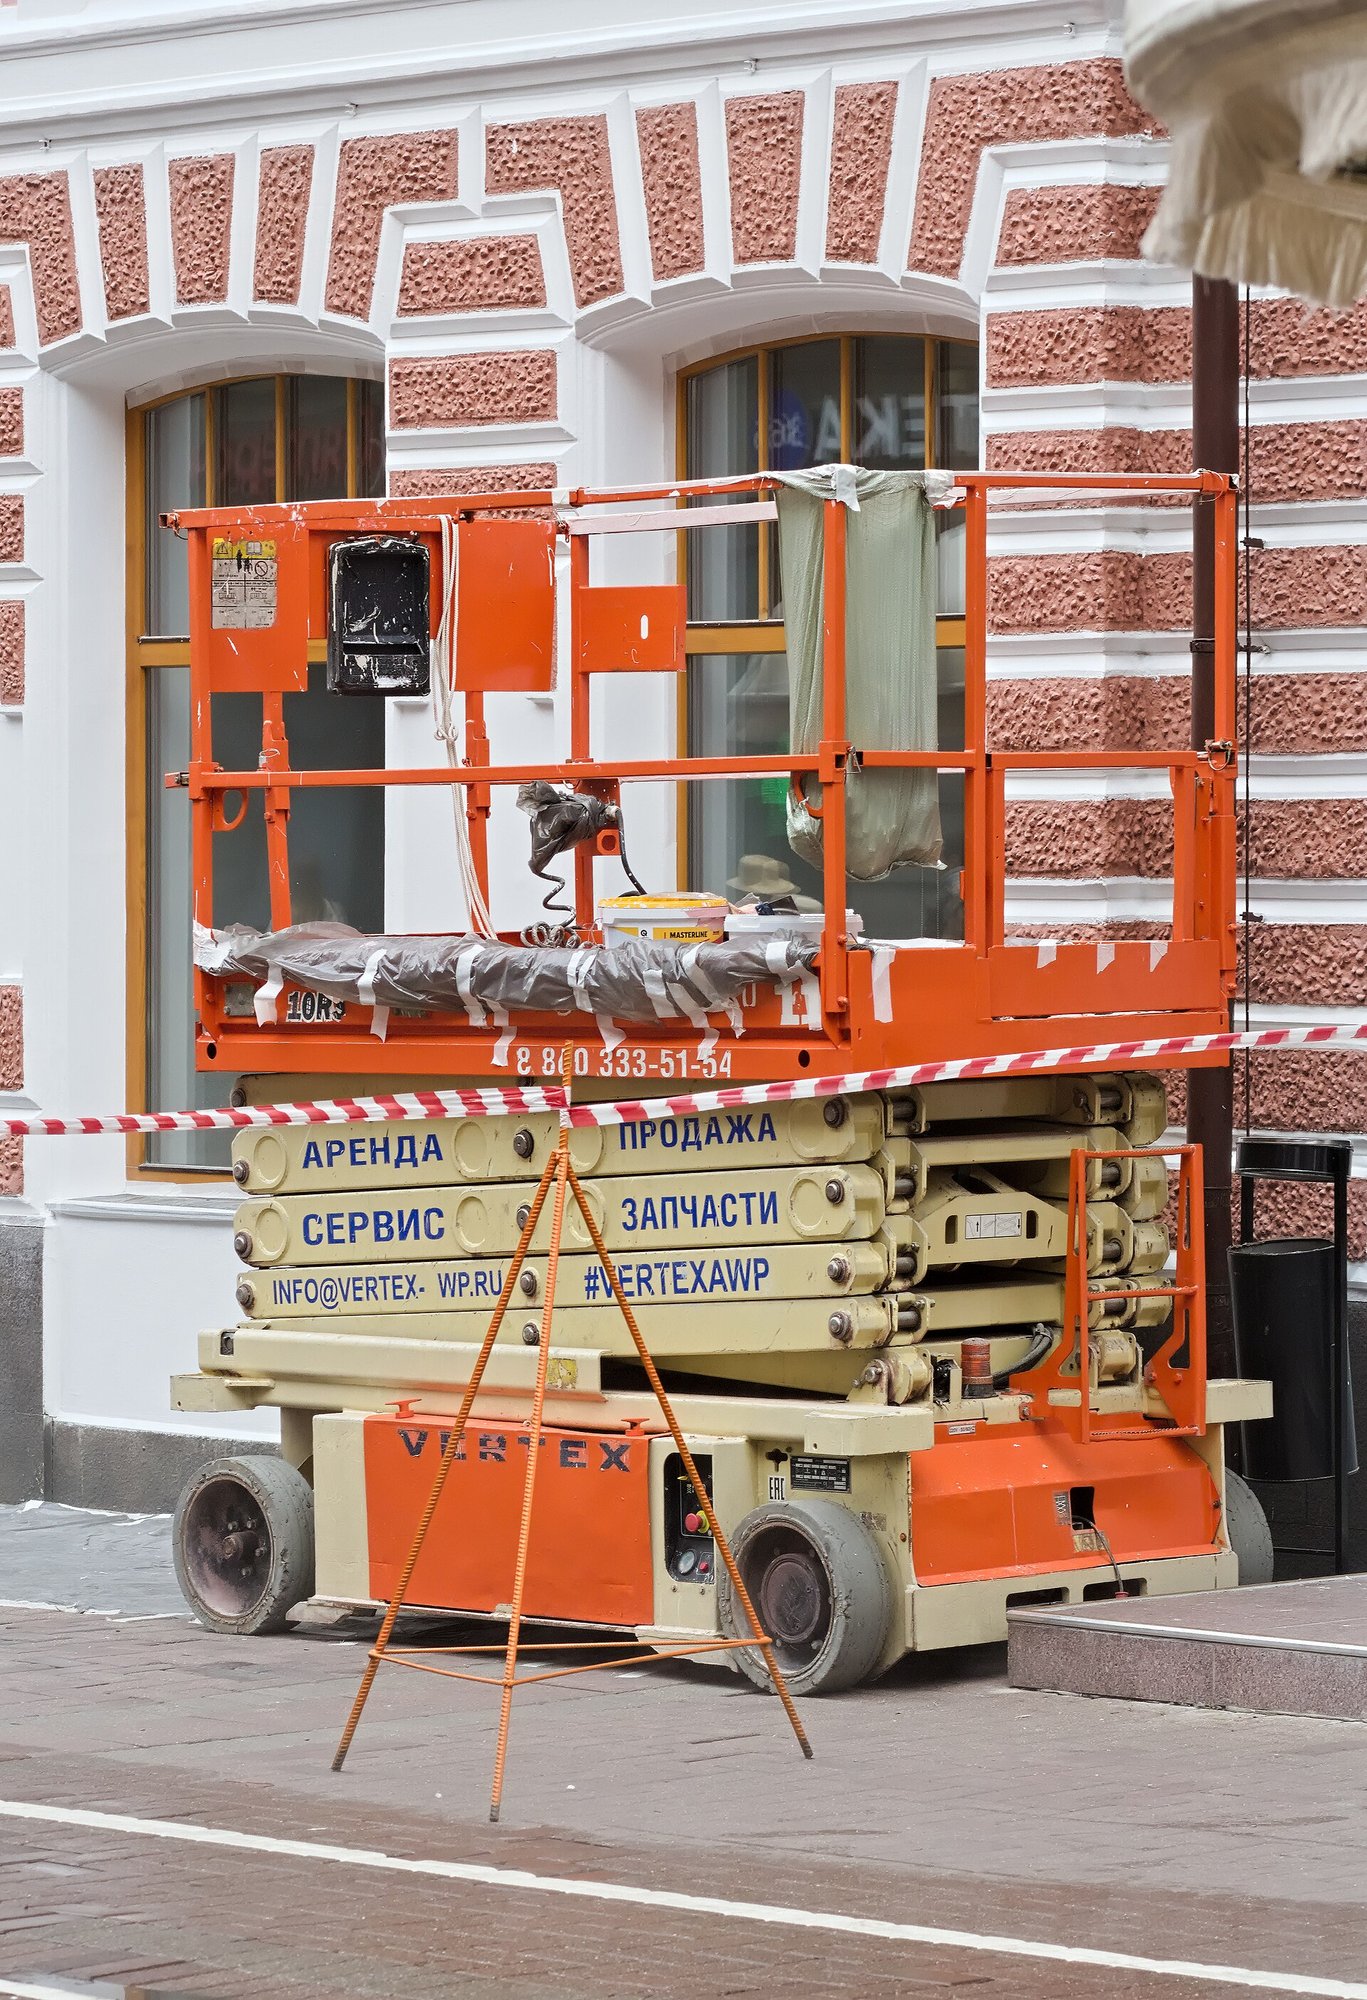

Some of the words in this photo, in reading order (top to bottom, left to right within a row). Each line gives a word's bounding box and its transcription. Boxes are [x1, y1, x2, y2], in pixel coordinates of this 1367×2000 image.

[669, 931, 708, 939] MASTERLINE
[599, 1048, 732, 1078] 333-51-54
[619, 1113, 777, 1152] ПРОДАЖА
[302, 1134, 444, 1169] АРЕНДА
[302, 1207, 445, 1246] СЕРВИС
[621, 1191, 778, 1231] ЗАПЧАСТИ
